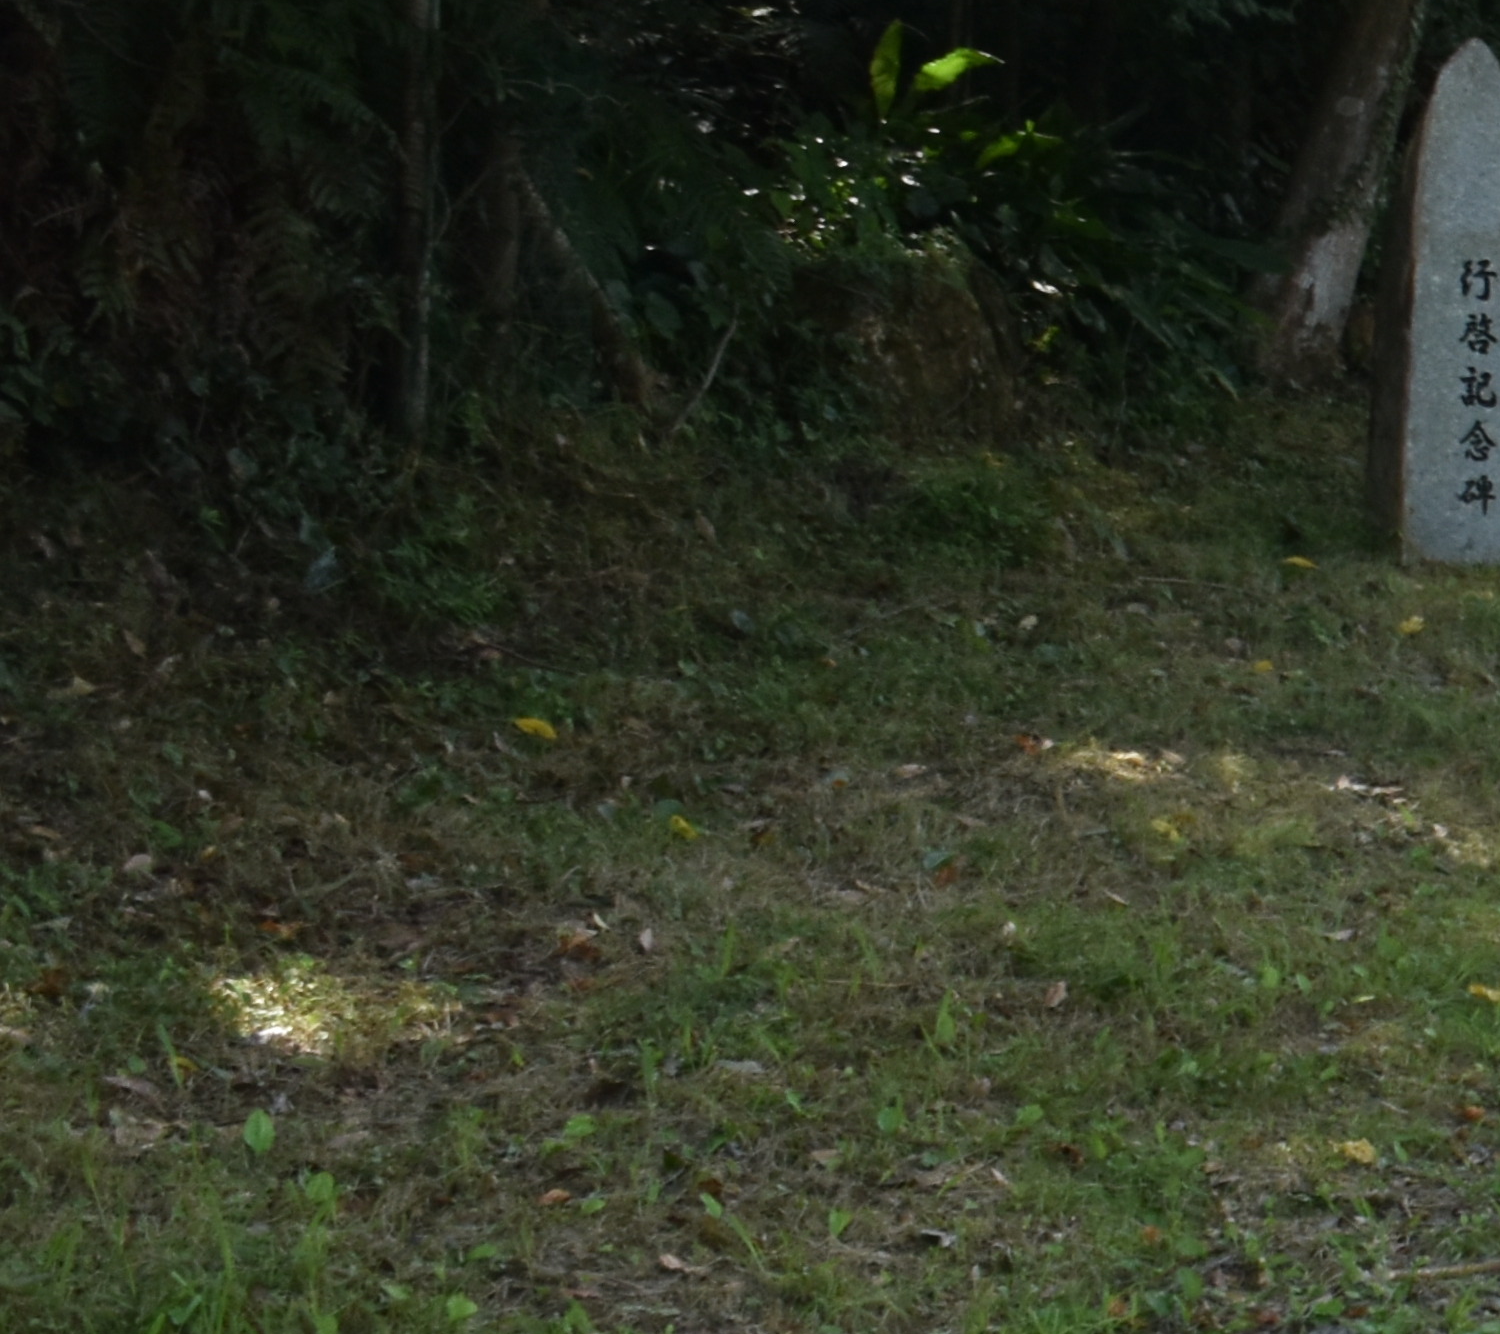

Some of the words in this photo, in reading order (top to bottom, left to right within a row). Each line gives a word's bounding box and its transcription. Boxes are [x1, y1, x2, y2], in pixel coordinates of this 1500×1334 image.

[1456, 258, 1499, 516] 行啓記念碑
